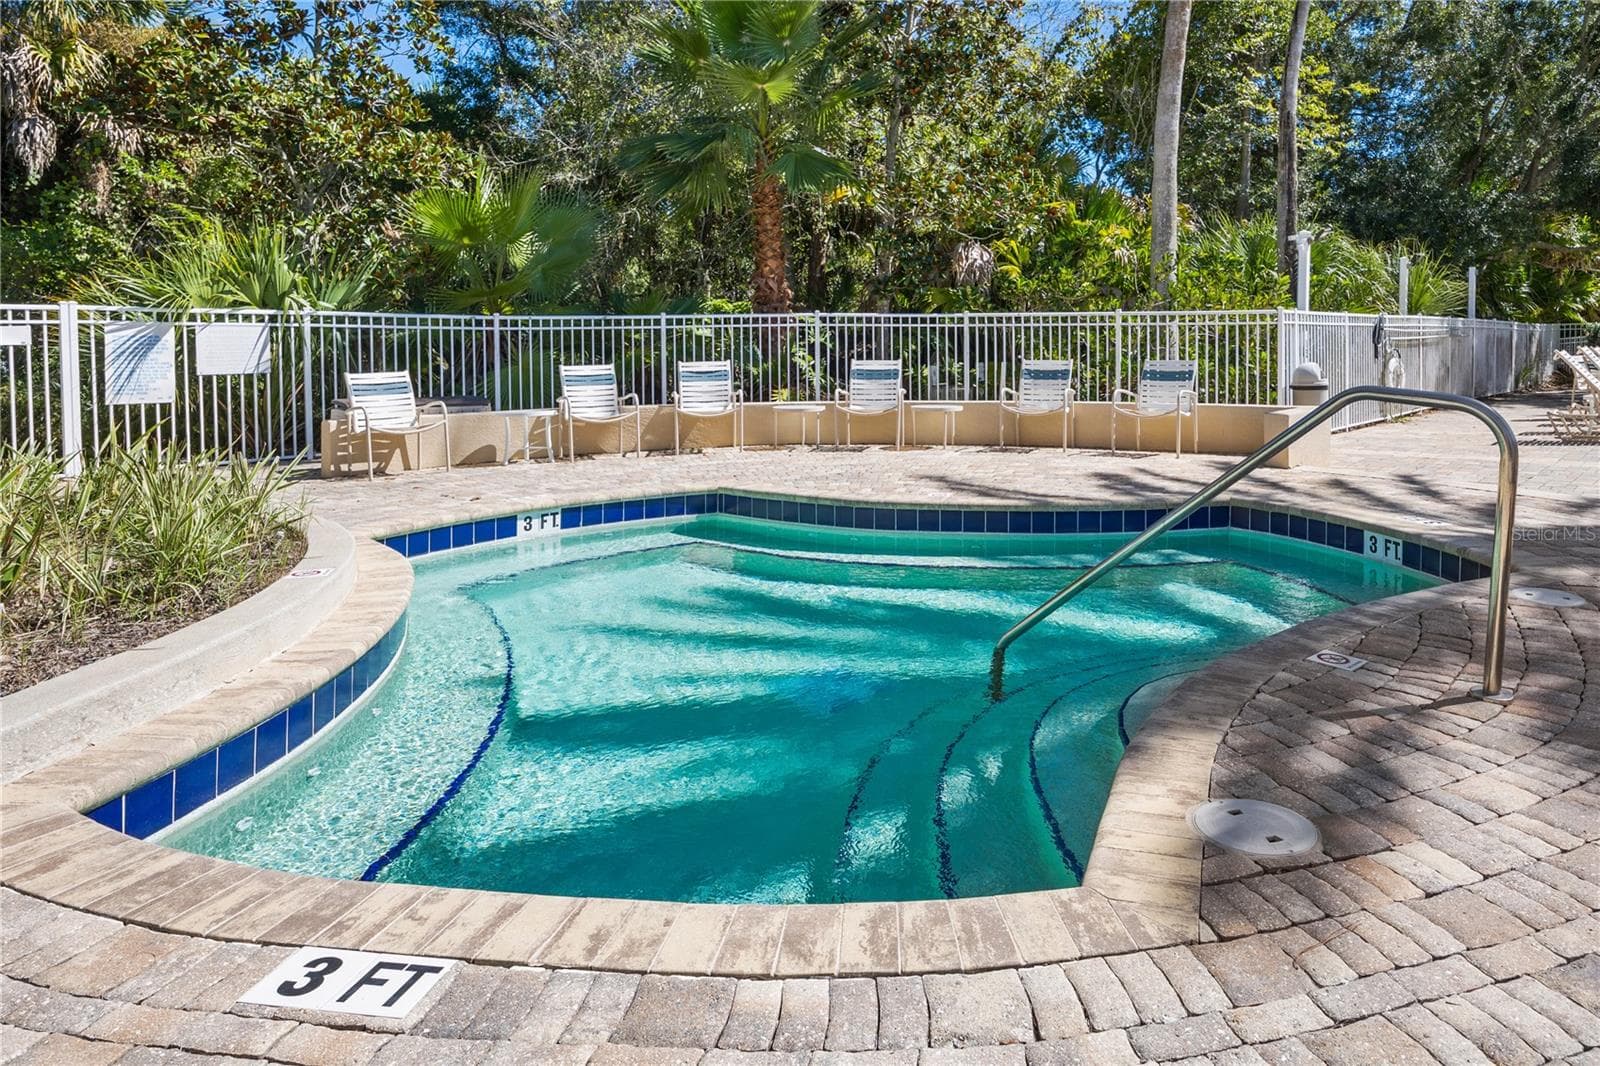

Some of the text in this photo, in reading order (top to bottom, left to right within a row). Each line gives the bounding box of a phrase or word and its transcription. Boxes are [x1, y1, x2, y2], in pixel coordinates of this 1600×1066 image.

[524, 512, 559, 532] 3 FT.
[1369, 535, 1400, 560] 3 FT.
[276, 956, 445, 1008] 3 FT
